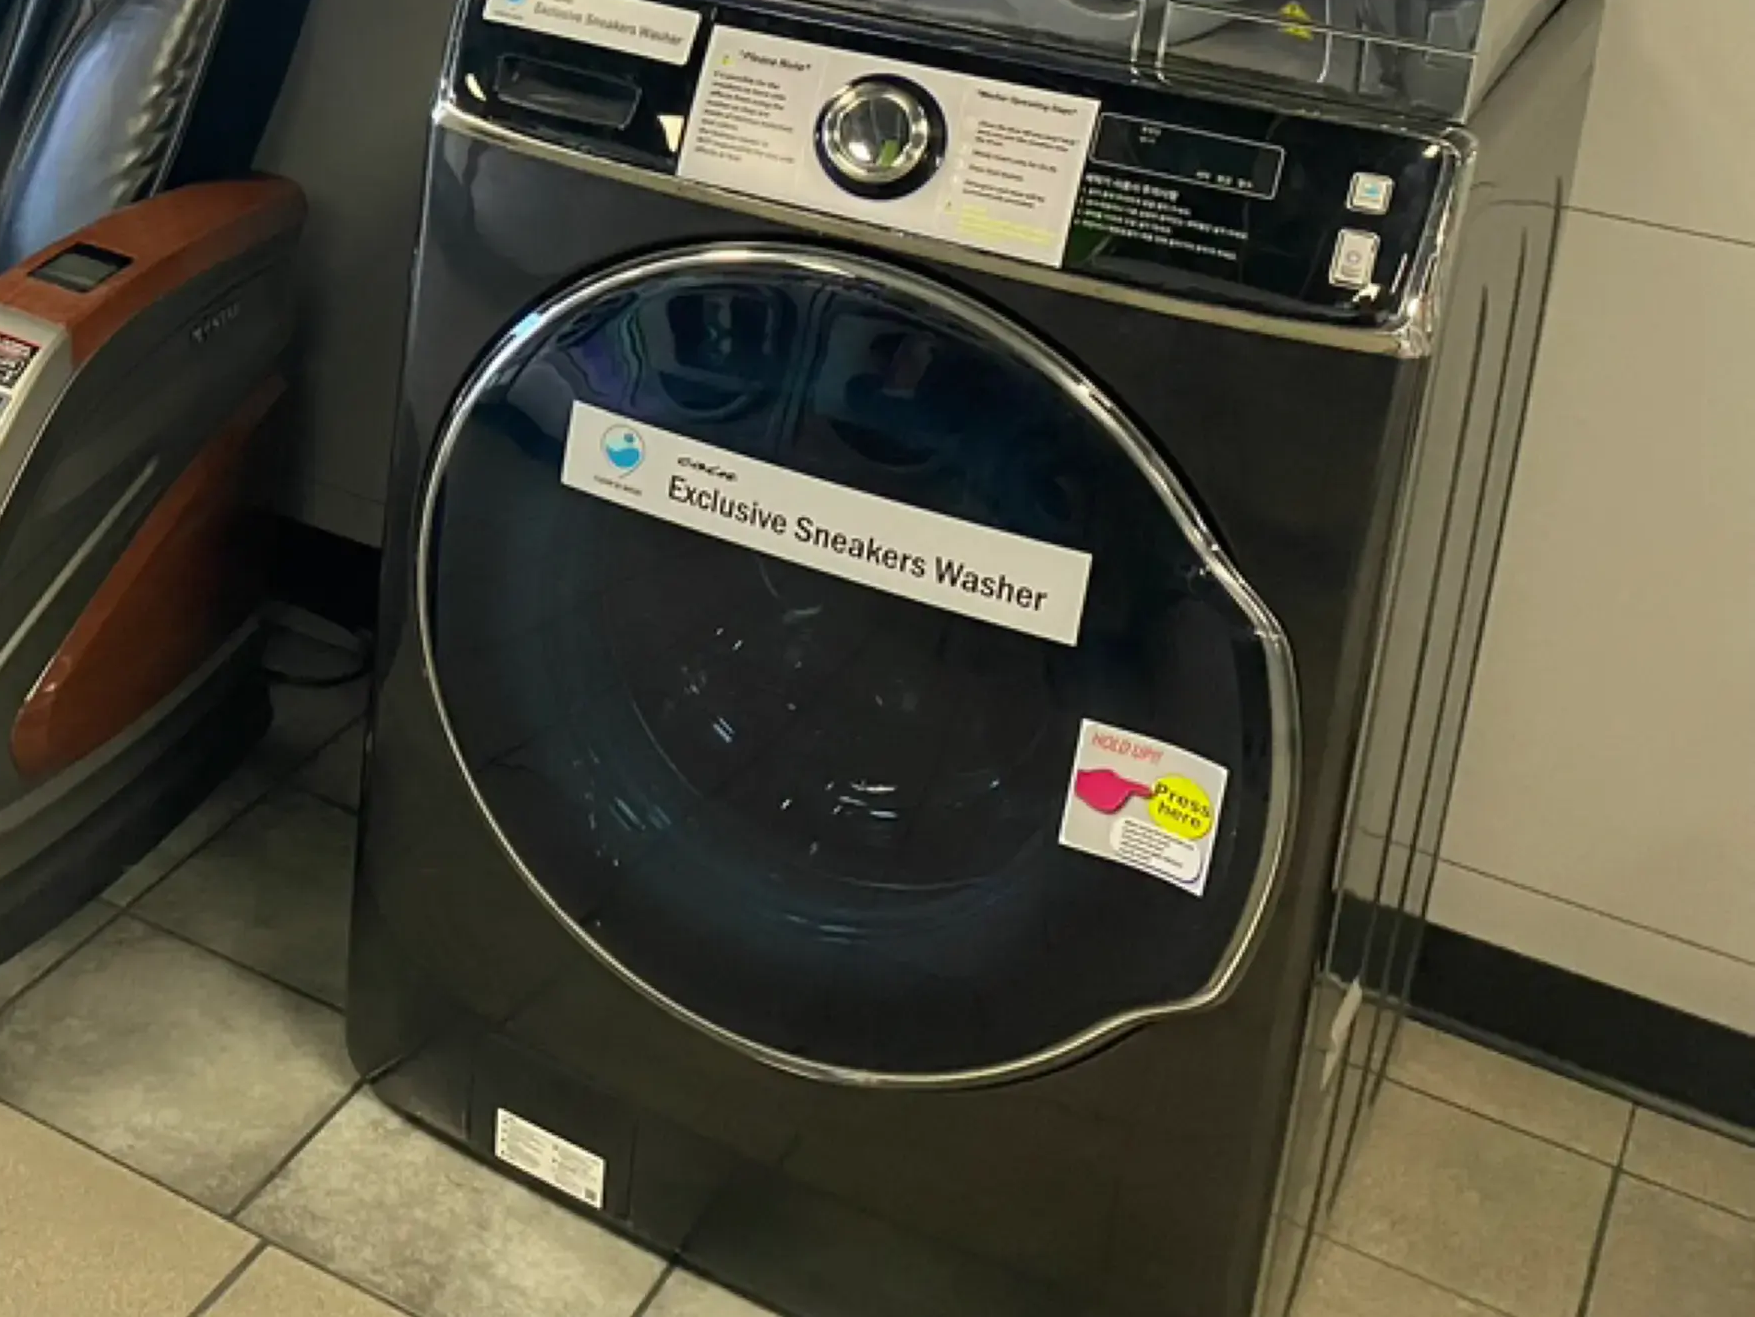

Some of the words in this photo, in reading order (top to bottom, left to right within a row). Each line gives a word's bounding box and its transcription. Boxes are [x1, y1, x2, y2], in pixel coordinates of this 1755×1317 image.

[666, 472, 789, 537] Exclusive
[793, 514, 929, 581] Sneakers
[933, 555, 1050, 614] Washer
[1154, 781, 1212, 819] Press
[1157, 800, 1202, 829] here
